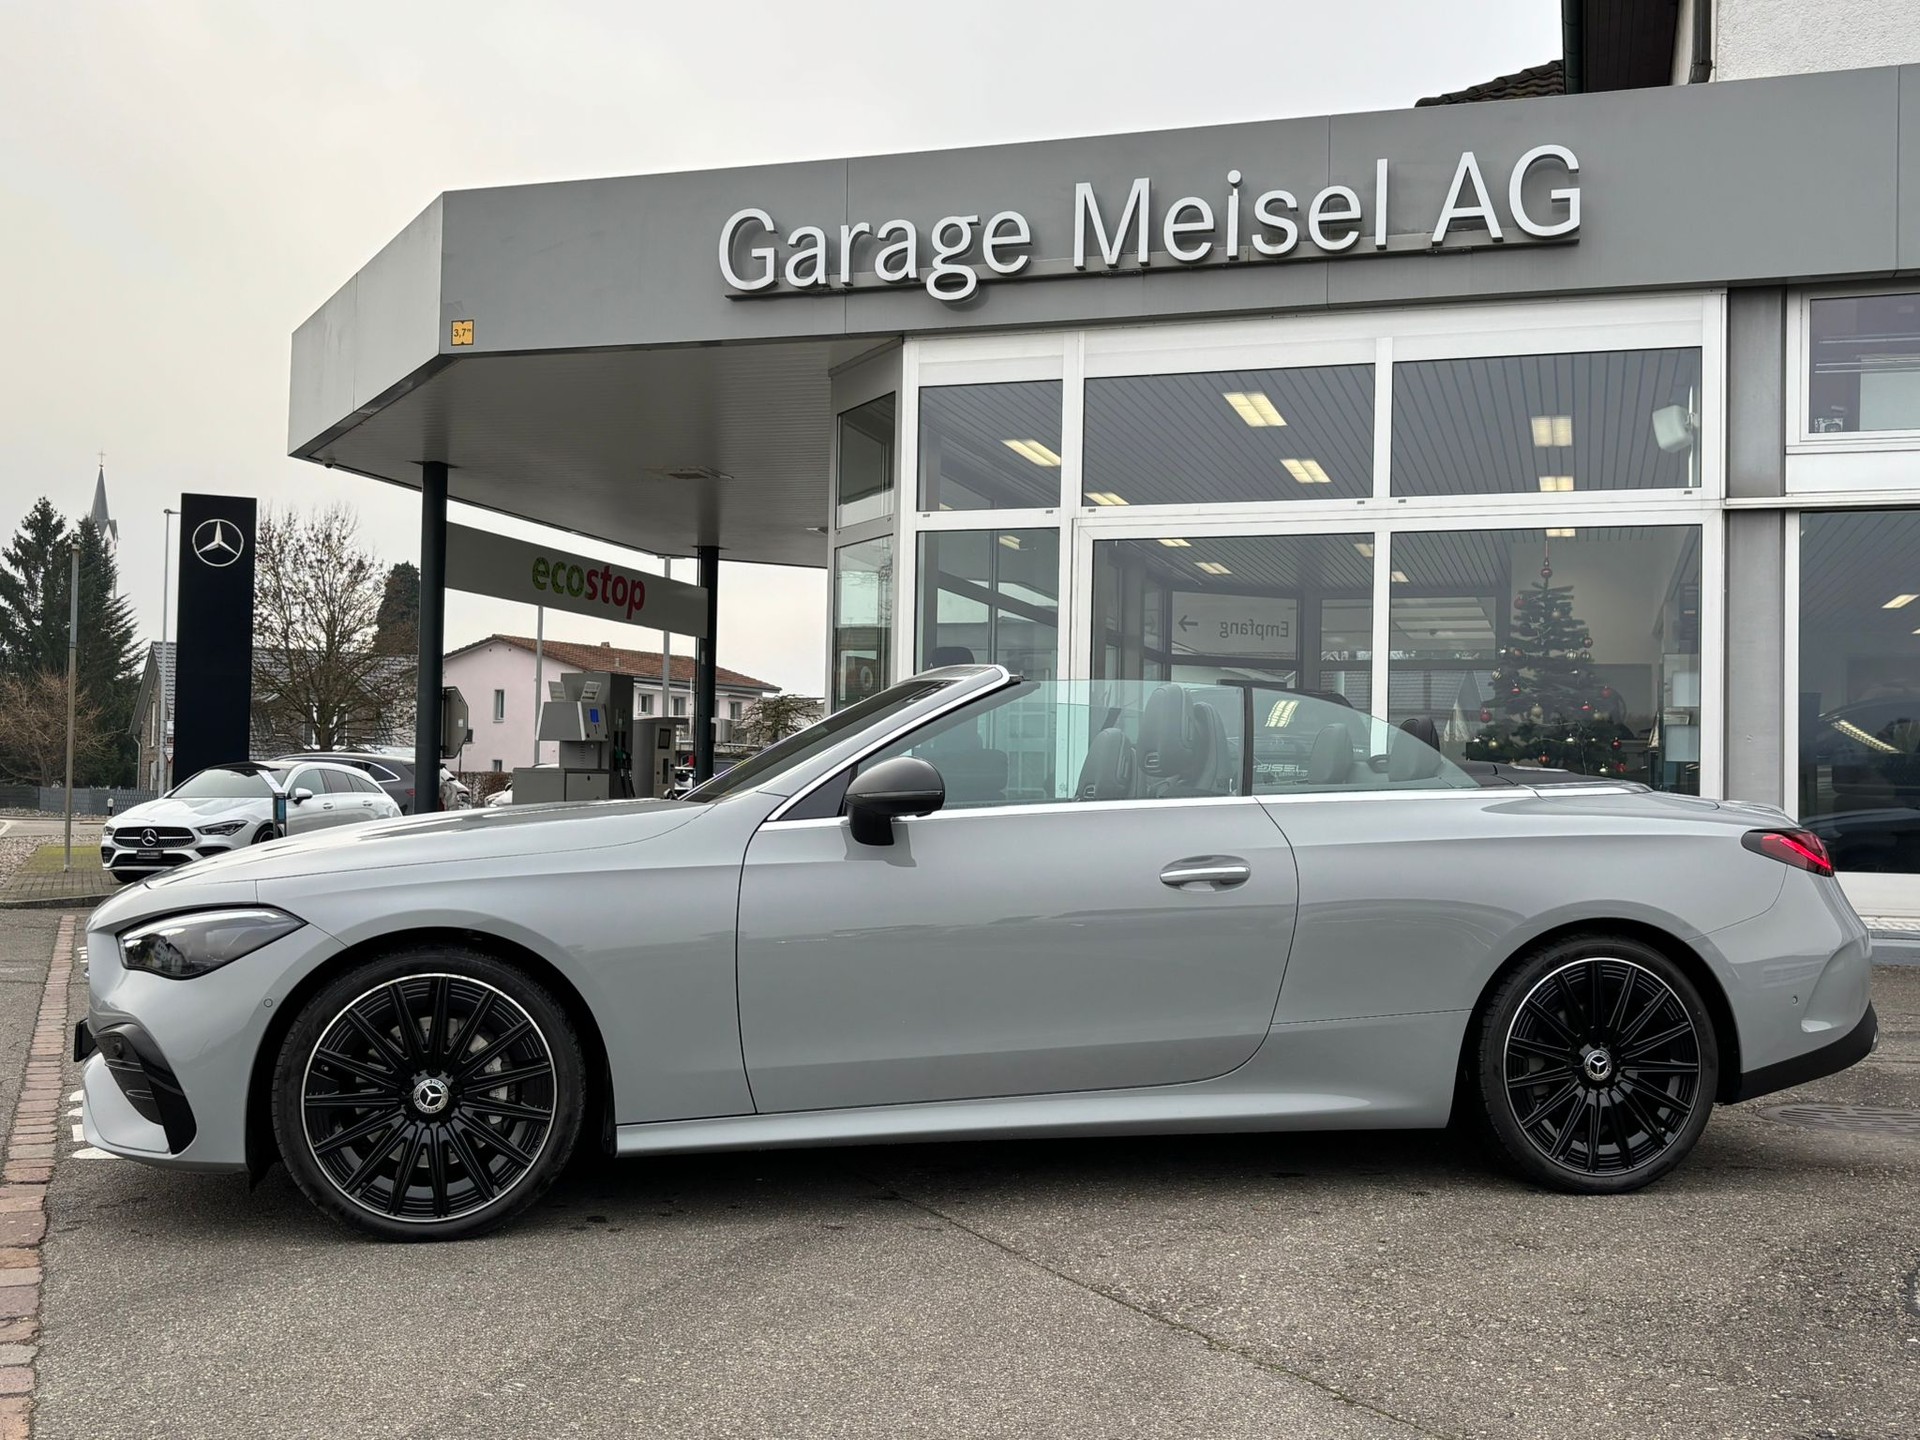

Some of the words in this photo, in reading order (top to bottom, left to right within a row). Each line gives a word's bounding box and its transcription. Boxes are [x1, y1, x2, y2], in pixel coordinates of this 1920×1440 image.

[718, 207, 1034, 301] Garage
[1073, 158, 1388, 269] Meisel
[1431, 144, 1581, 244] AG
[531, 557, 646, 620] ecostop
